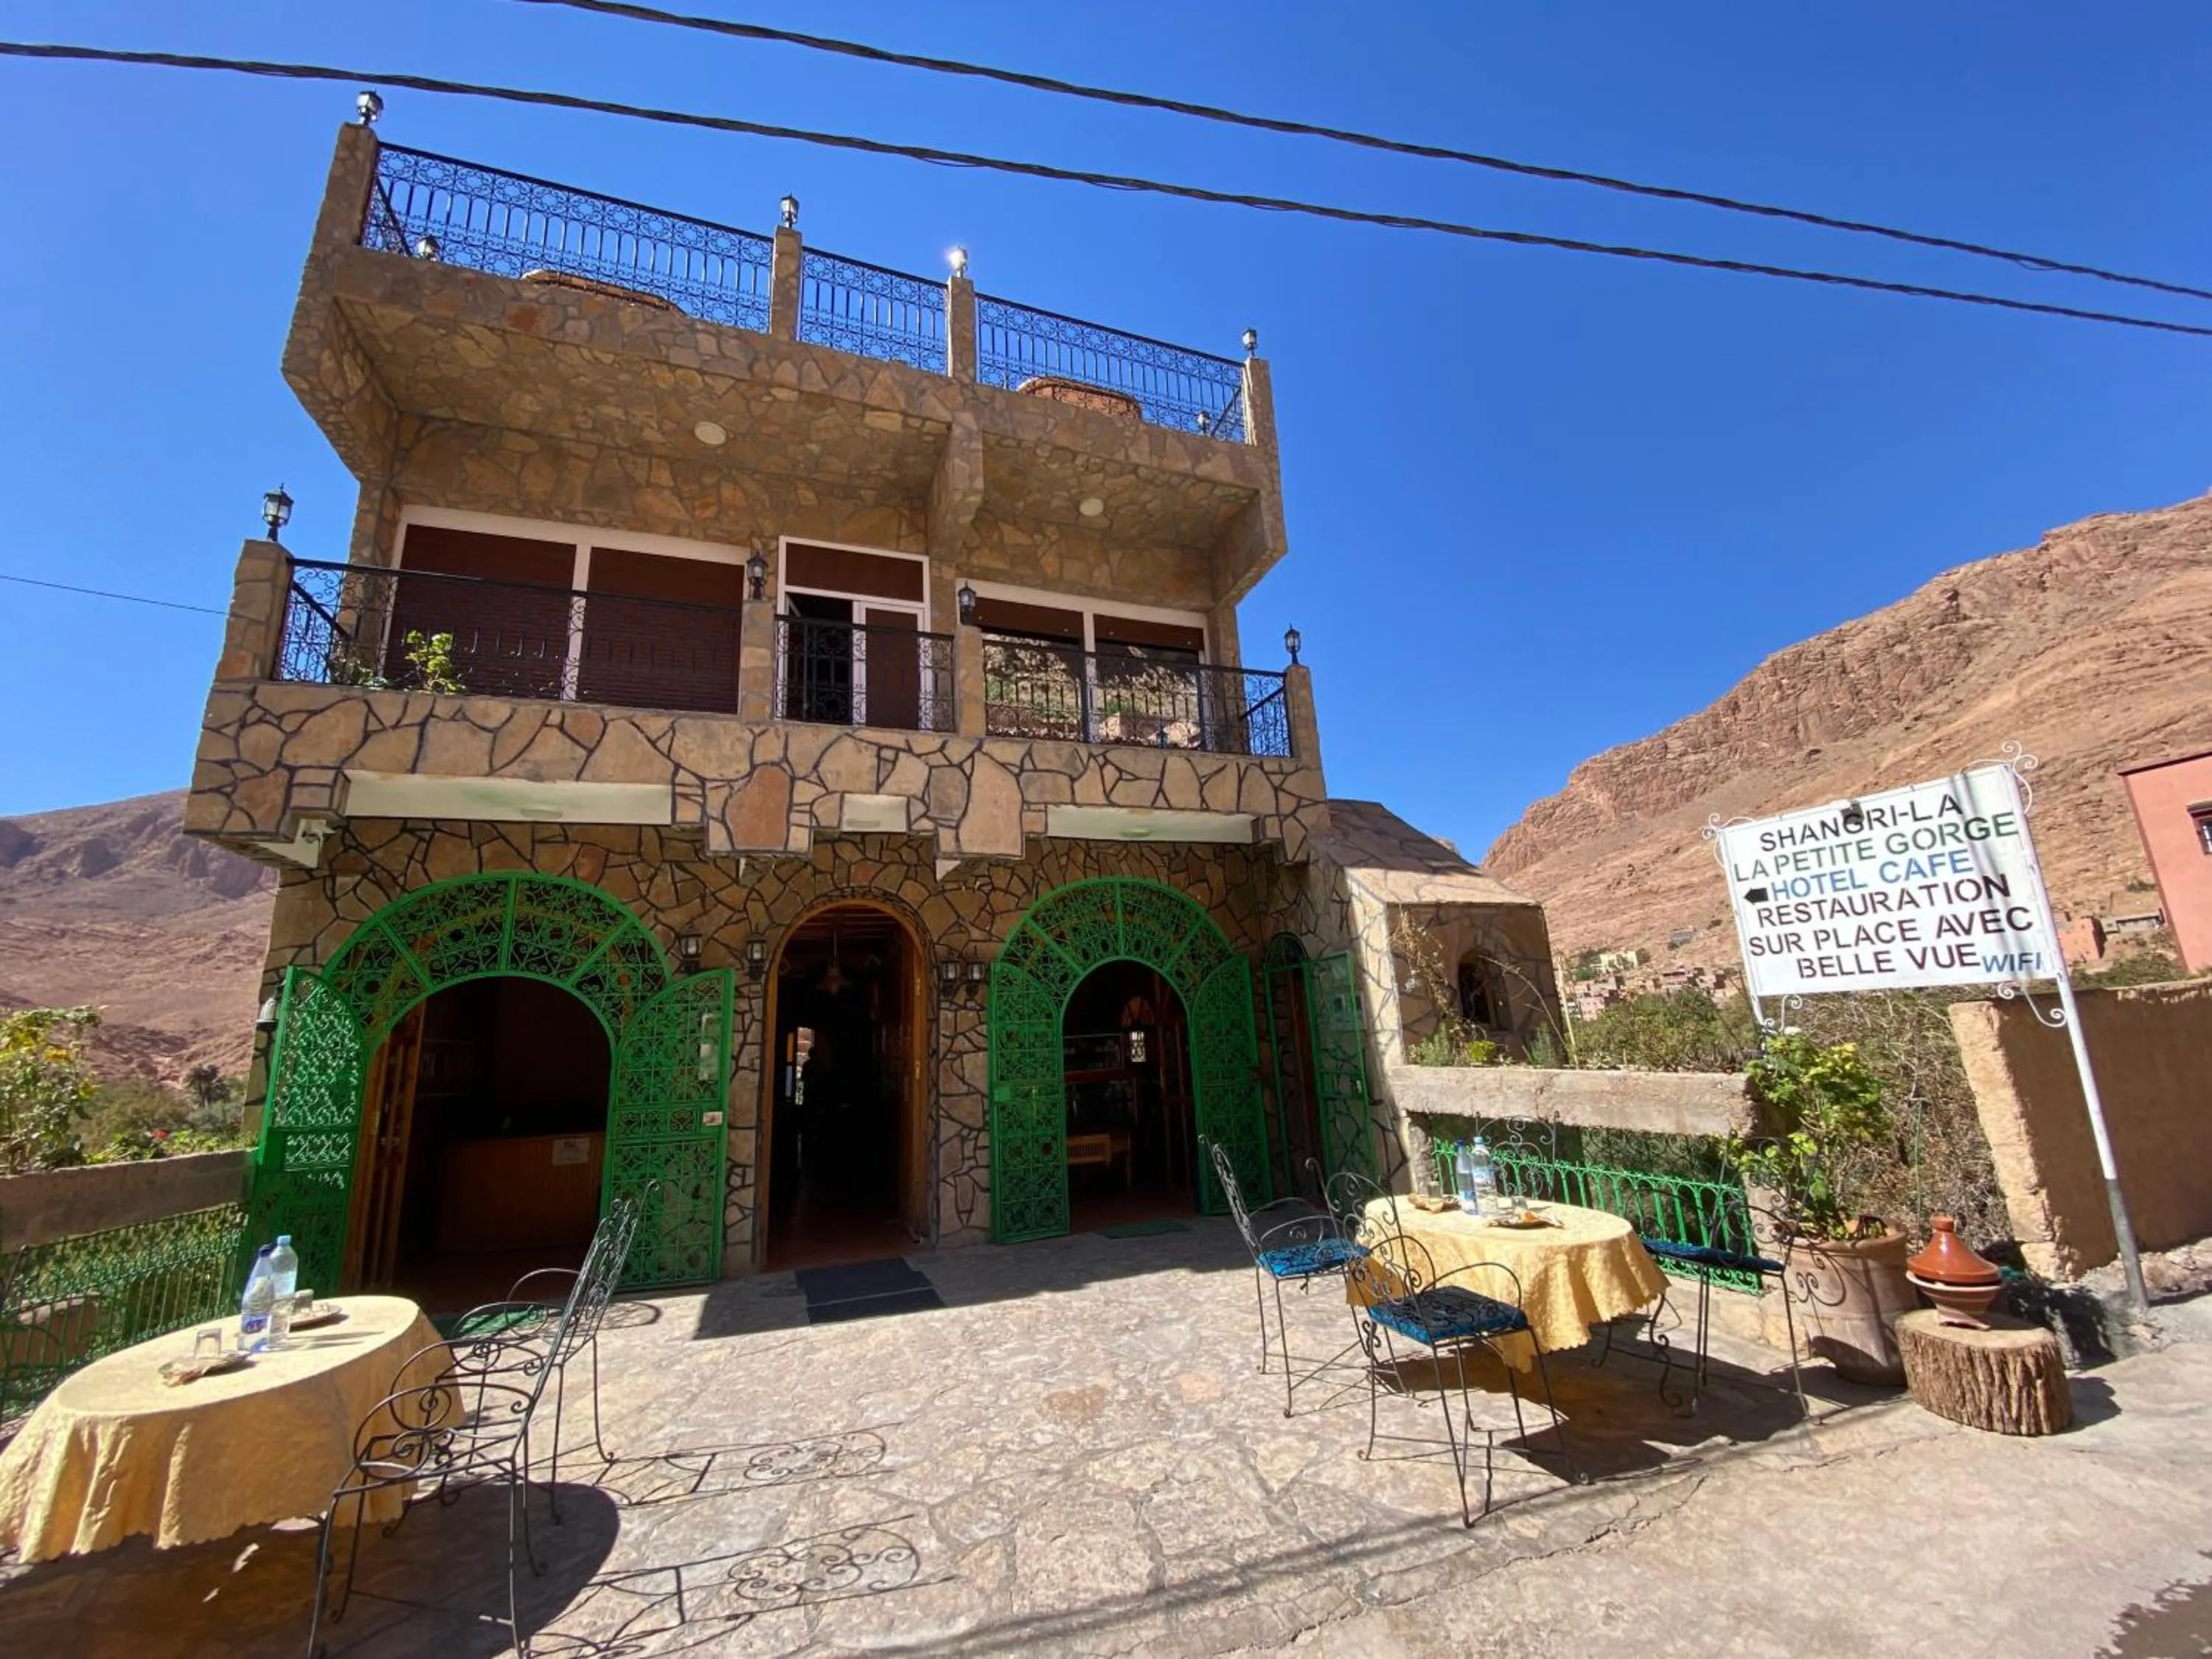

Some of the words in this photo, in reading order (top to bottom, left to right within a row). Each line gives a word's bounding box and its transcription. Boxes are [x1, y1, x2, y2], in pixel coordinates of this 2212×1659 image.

[1734, 859, 1769, 883] LA
[1774, 838, 1877, 874] PETITE
[1885, 812, 2020, 855] GORGE
[1760, 793, 1964, 852] SHANGRI-LA
[1757, 873, 2011, 928] RESTAURATION
[1771, 869, 1868, 902] HOTEL
[1879, 848, 1975, 884] CAFE
[1749, 930, 1804, 958] SUR
[1813, 919, 1921, 951] PLACE
[1935, 906, 2034, 939] AVEC
[1798, 951, 1896, 978] BELLE
[1905, 943, 1980, 970] VUE
[1982, 952, 2042, 974] WIFI
